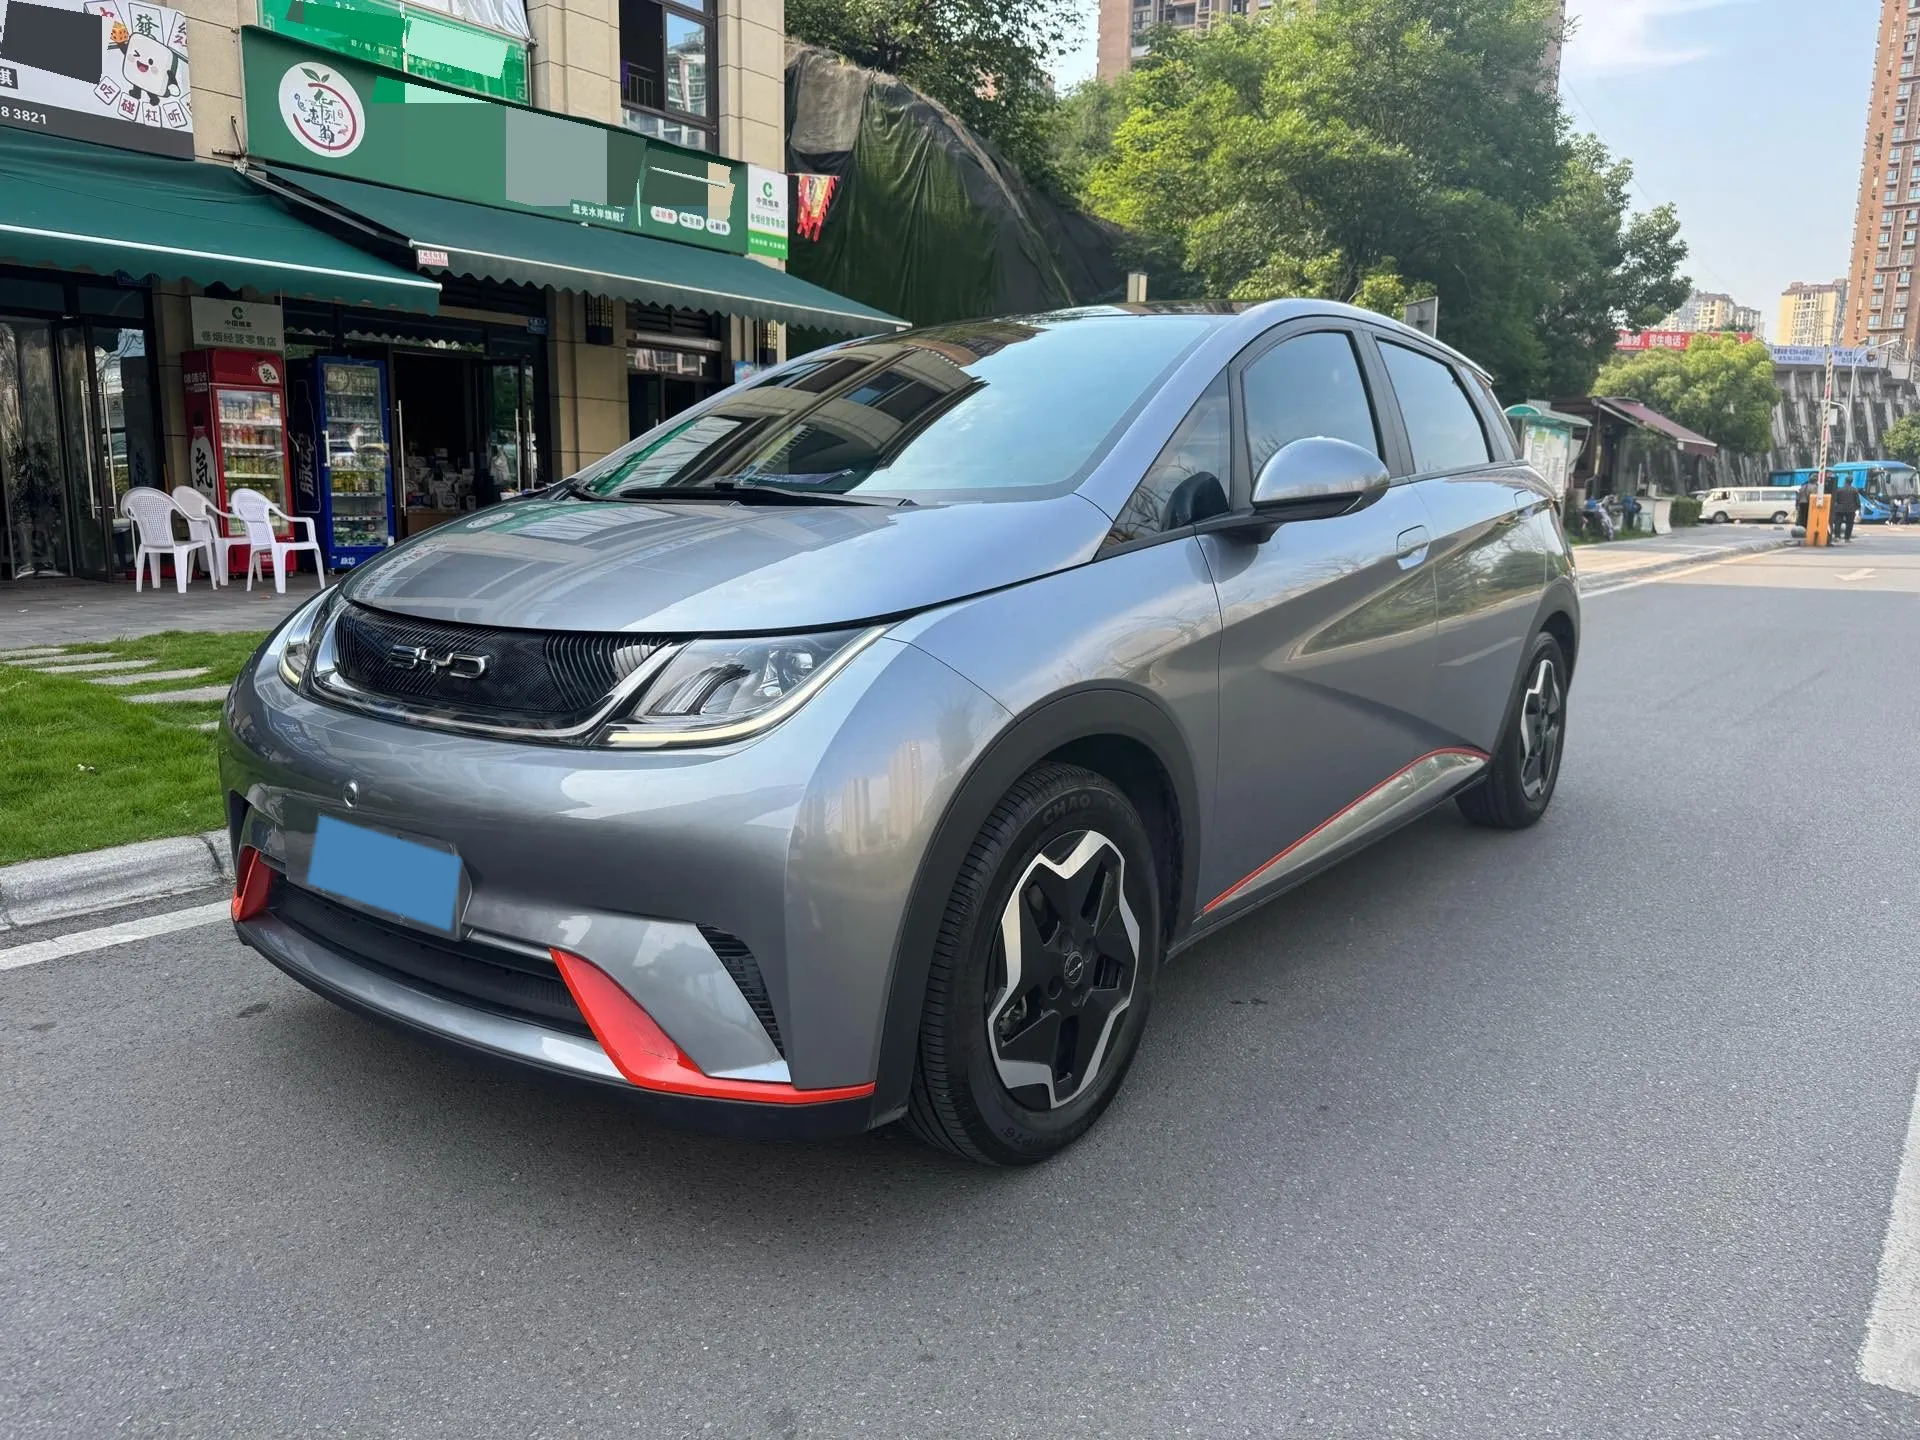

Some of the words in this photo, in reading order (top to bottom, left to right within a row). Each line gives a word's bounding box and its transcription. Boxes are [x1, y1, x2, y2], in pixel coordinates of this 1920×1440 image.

[13, 108, 48, 125] 3821
[99, 83, 115, 99] 吃
[120, 99, 137, 116] 碰
[168, 109, 183, 123] 听
[390, 645, 490, 679] BYD
[1042, 792, 1092, 826] CHAO
